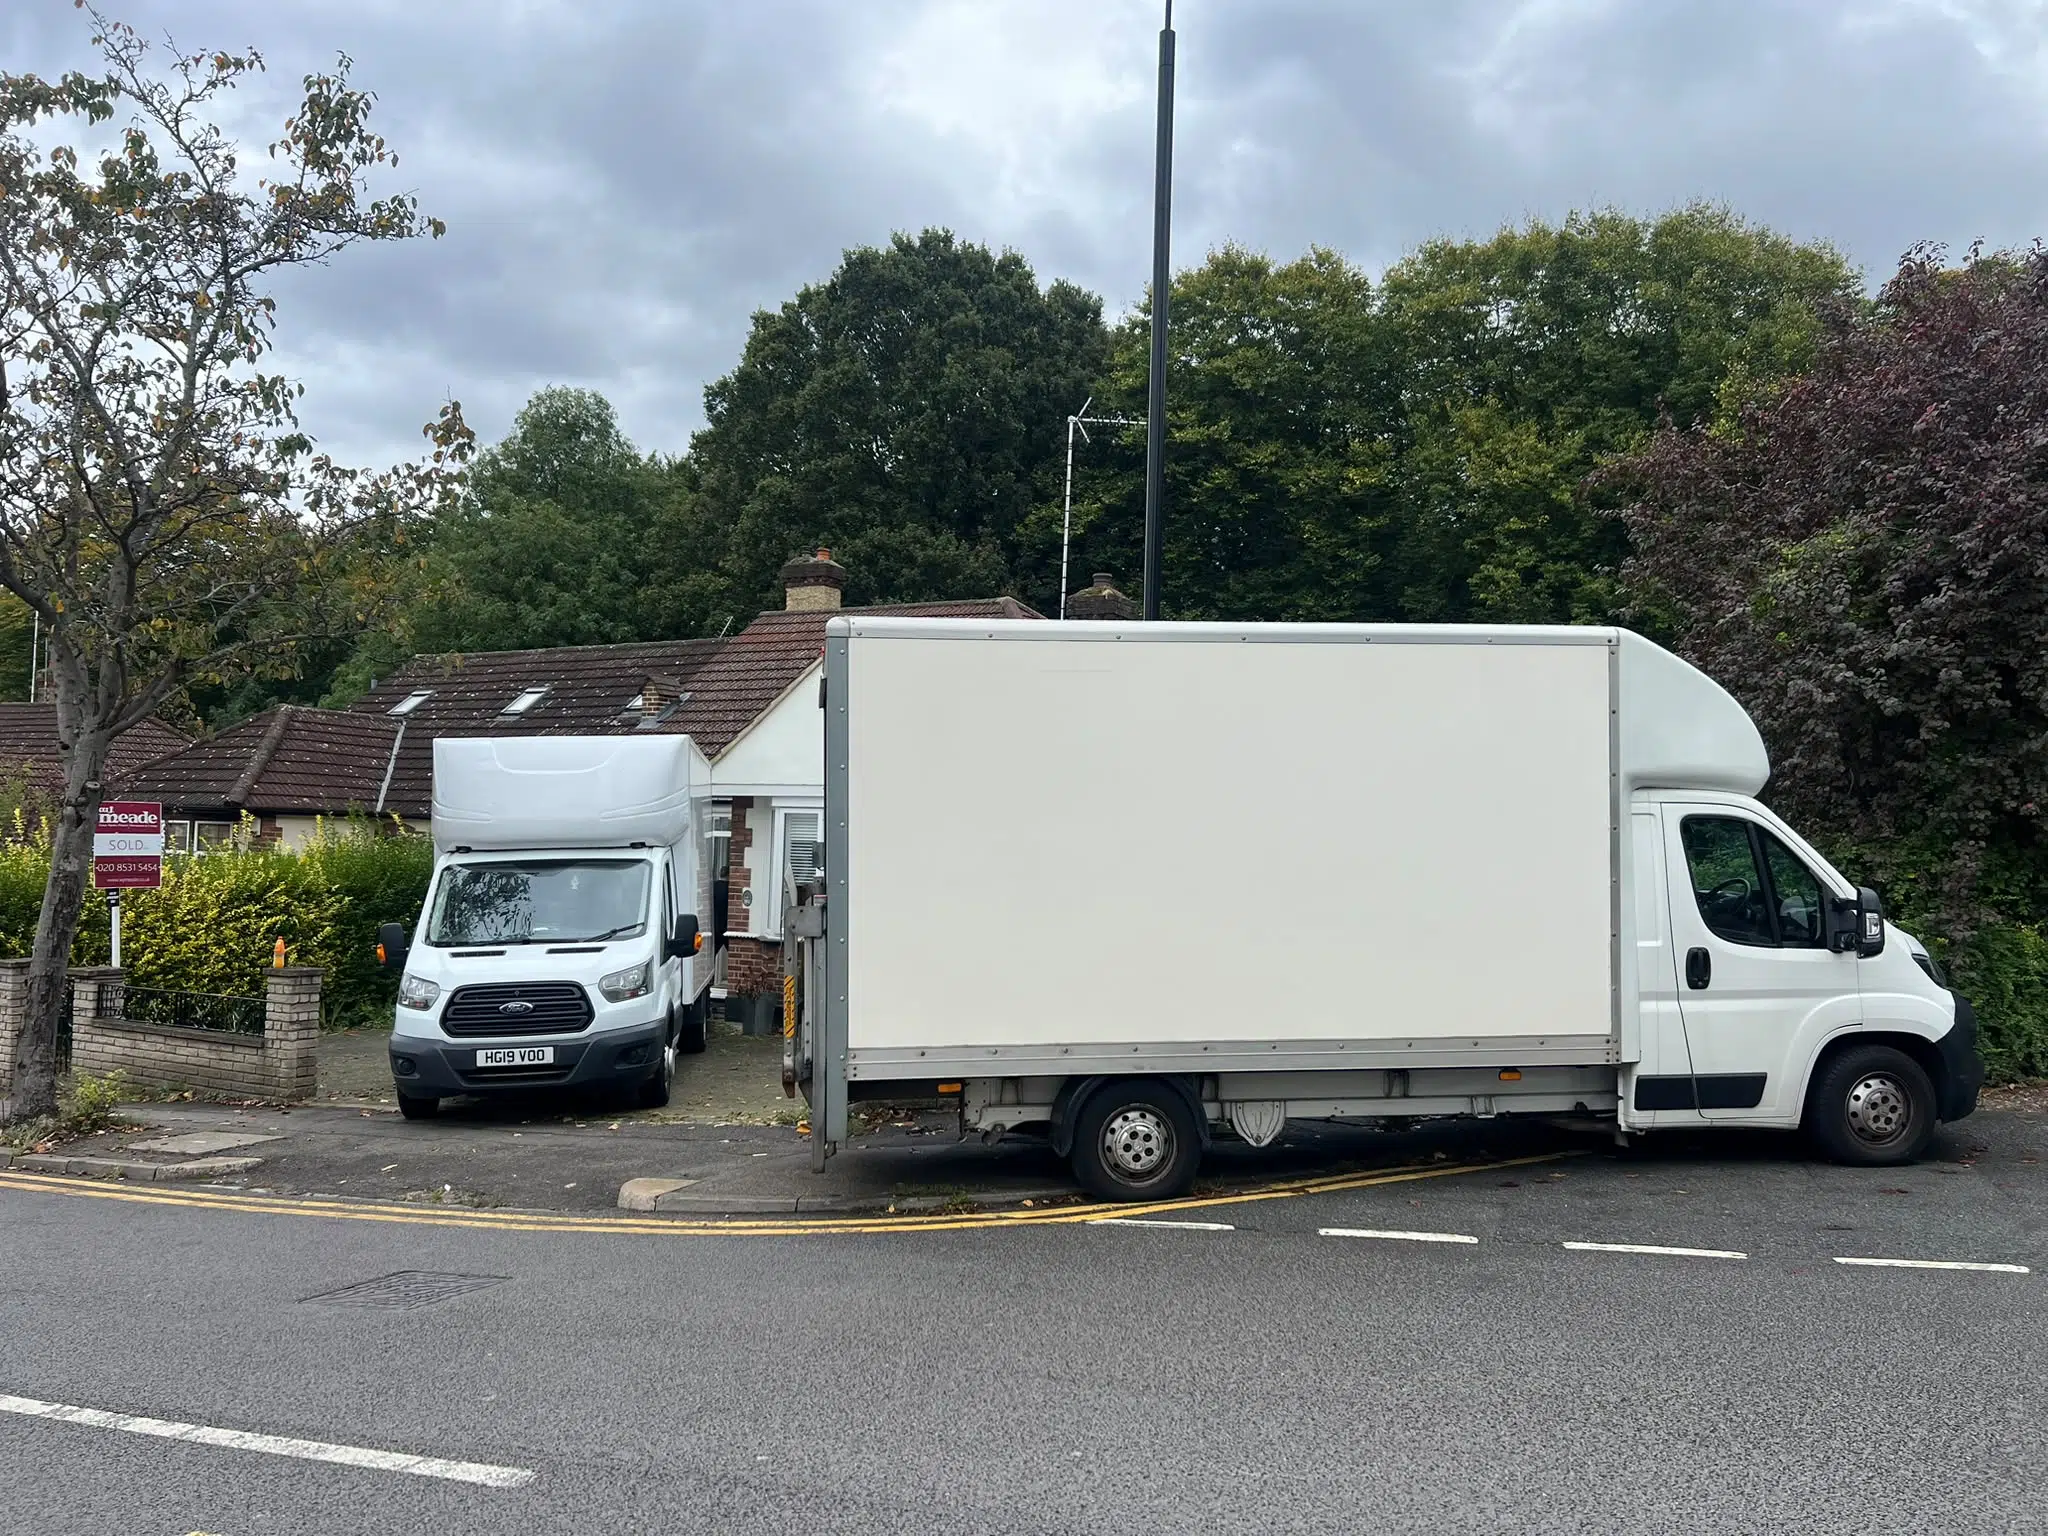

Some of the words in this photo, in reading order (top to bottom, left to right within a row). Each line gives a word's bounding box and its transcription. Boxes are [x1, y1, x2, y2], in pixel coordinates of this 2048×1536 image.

[98, 811, 158, 824] meade
[108, 839, 144, 851] SOLD
[97, 863, 115, 872] 020
[116, 863, 136, 872] 8531
[138, 863, 157, 872] 5454
[506, 1003, 526, 1012] Ford
[485, 1050, 515, 1064] HG19
